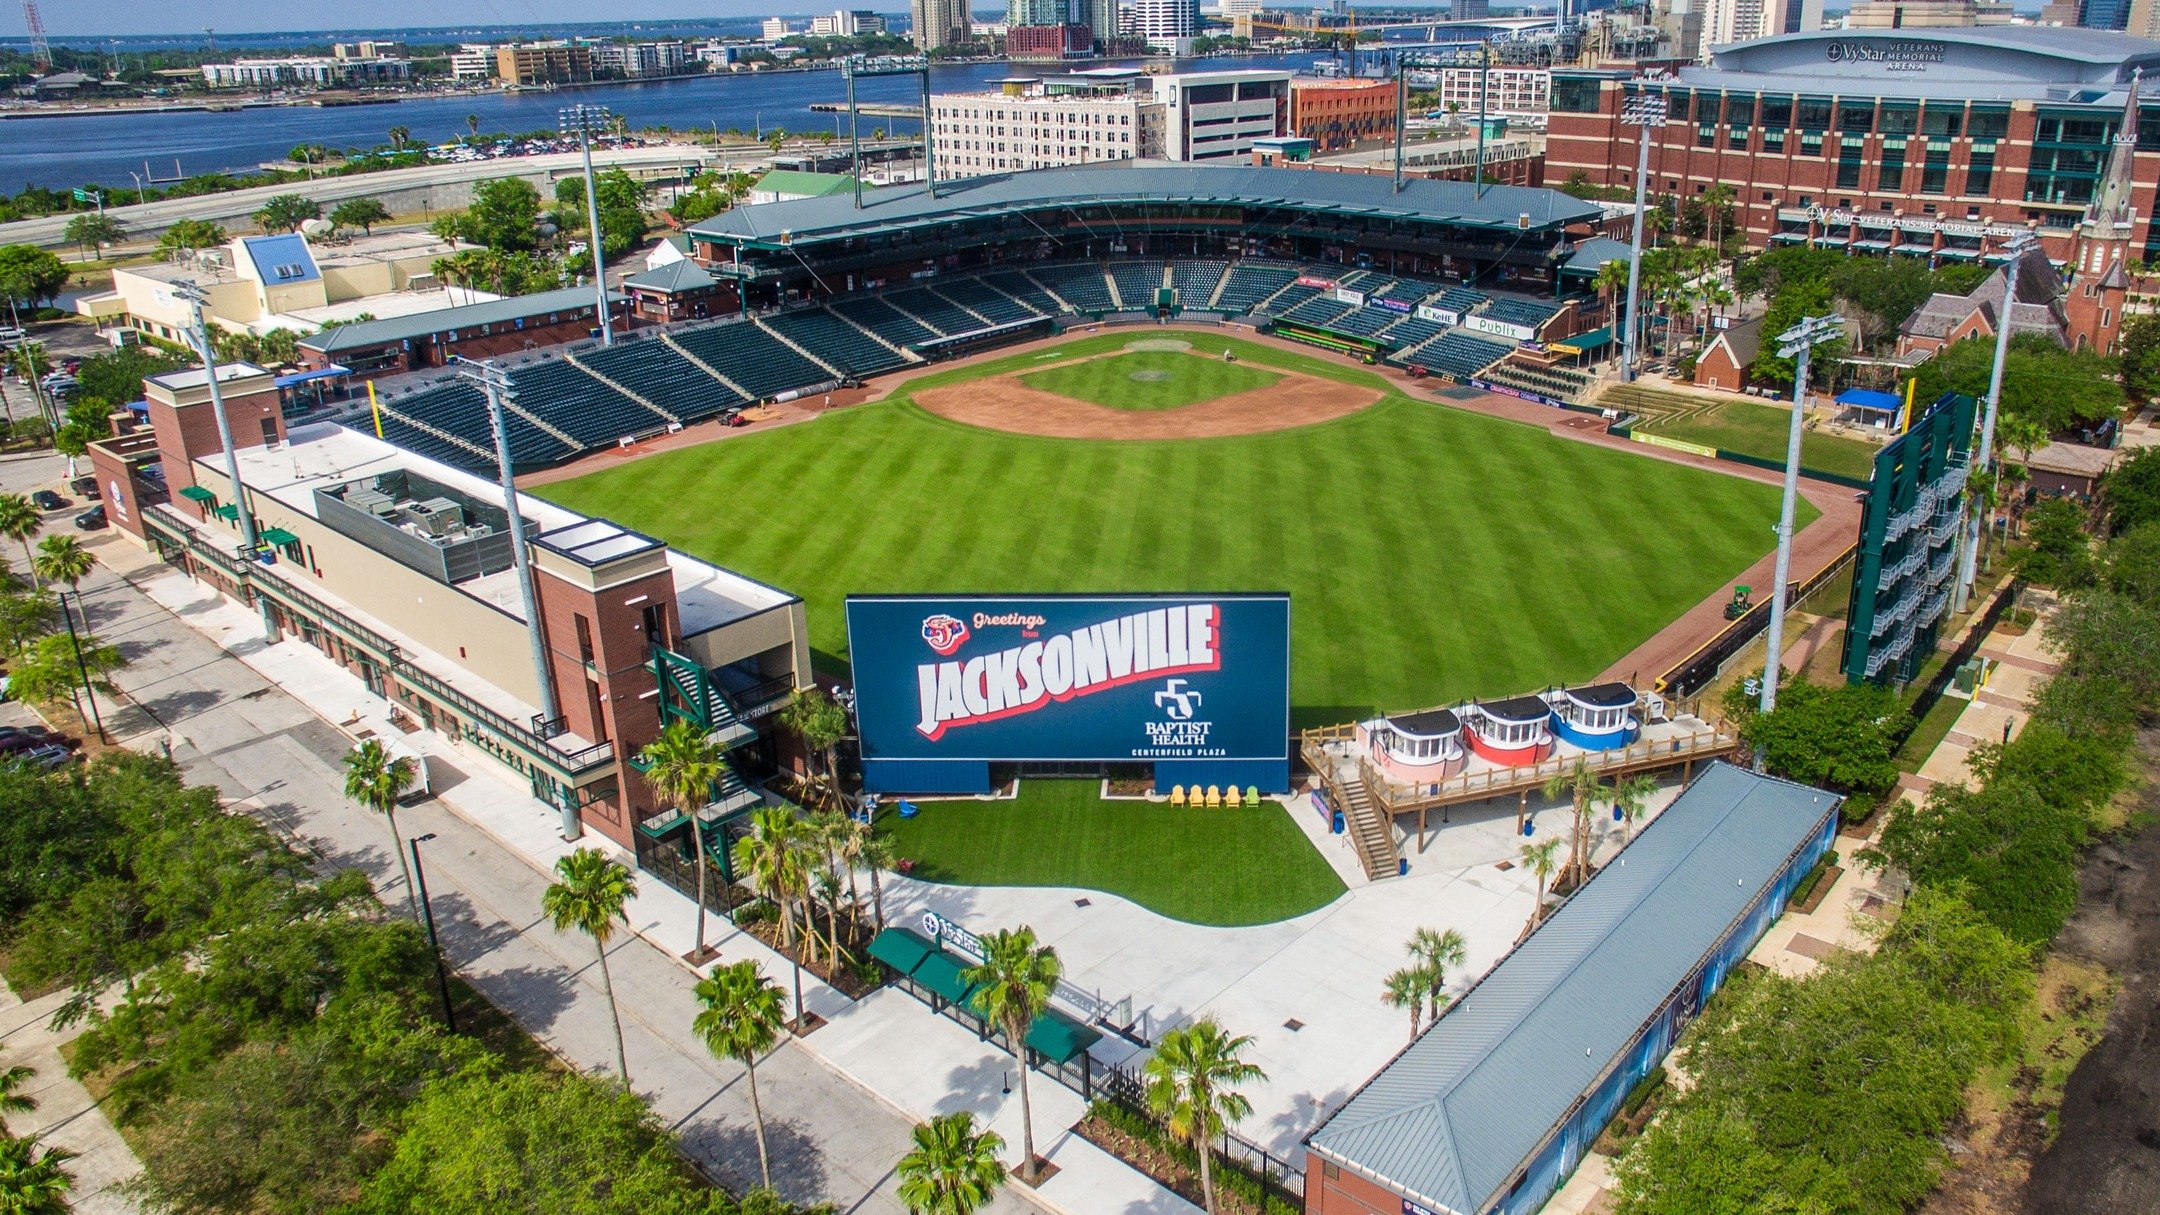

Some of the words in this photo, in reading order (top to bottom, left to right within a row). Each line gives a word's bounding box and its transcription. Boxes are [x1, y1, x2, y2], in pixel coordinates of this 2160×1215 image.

[1842, 44, 1886, 63] VyStar
[1887, 53, 1943, 61] MEMORIAL
[1886, 62, 1924, 70] ARENA
[1819, 207, 1855, 223] VStar
[1859, 215, 1916, 228] VETERANS
[1920, 221, 1979, 234] MEMORIAL
[1983, 227, 2016, 237] AREN
[1432, 312, 1453, 323] KeHE
[1479, 319, 1516, 337] Publix
[973, 613, 1046, 630] Greetings
[916, 604, 1213, 736] JACKSONVILLE
[751, 704, 769, 717] STORE
[1145, 722, 1212, 734] BAPTIST
[1152, 735, 1205, 745] HEALTH
